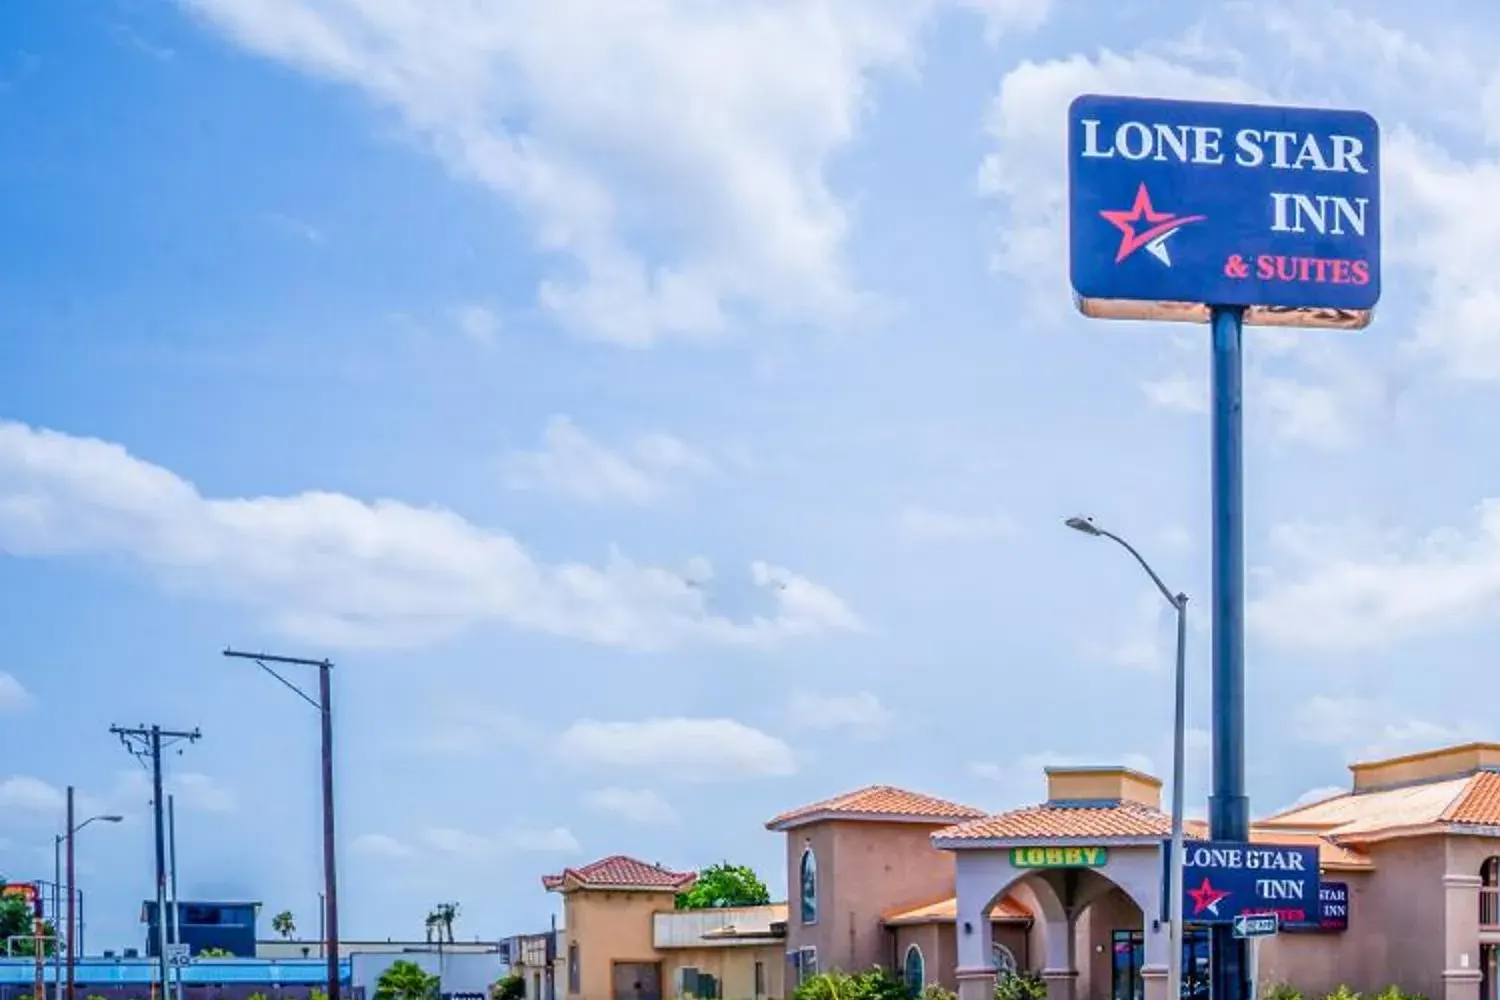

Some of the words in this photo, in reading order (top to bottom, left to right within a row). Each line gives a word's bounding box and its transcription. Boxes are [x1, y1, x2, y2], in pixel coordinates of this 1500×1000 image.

[1080, 118, 1224, 165] LONE
[1234, 128, 1369, 174] STAR
[1270, 192, 1369, 237] INN
[1223, 254, 1249, 279] &
[1256, 254, 1370, 285] SUITES
[1015, 847, 1097, 866] LOBBY
[1181, 847, 1242, 868] LONE
[1256, 879, 1305, 900] INN
[1324, 905, 1346, 917] INN
